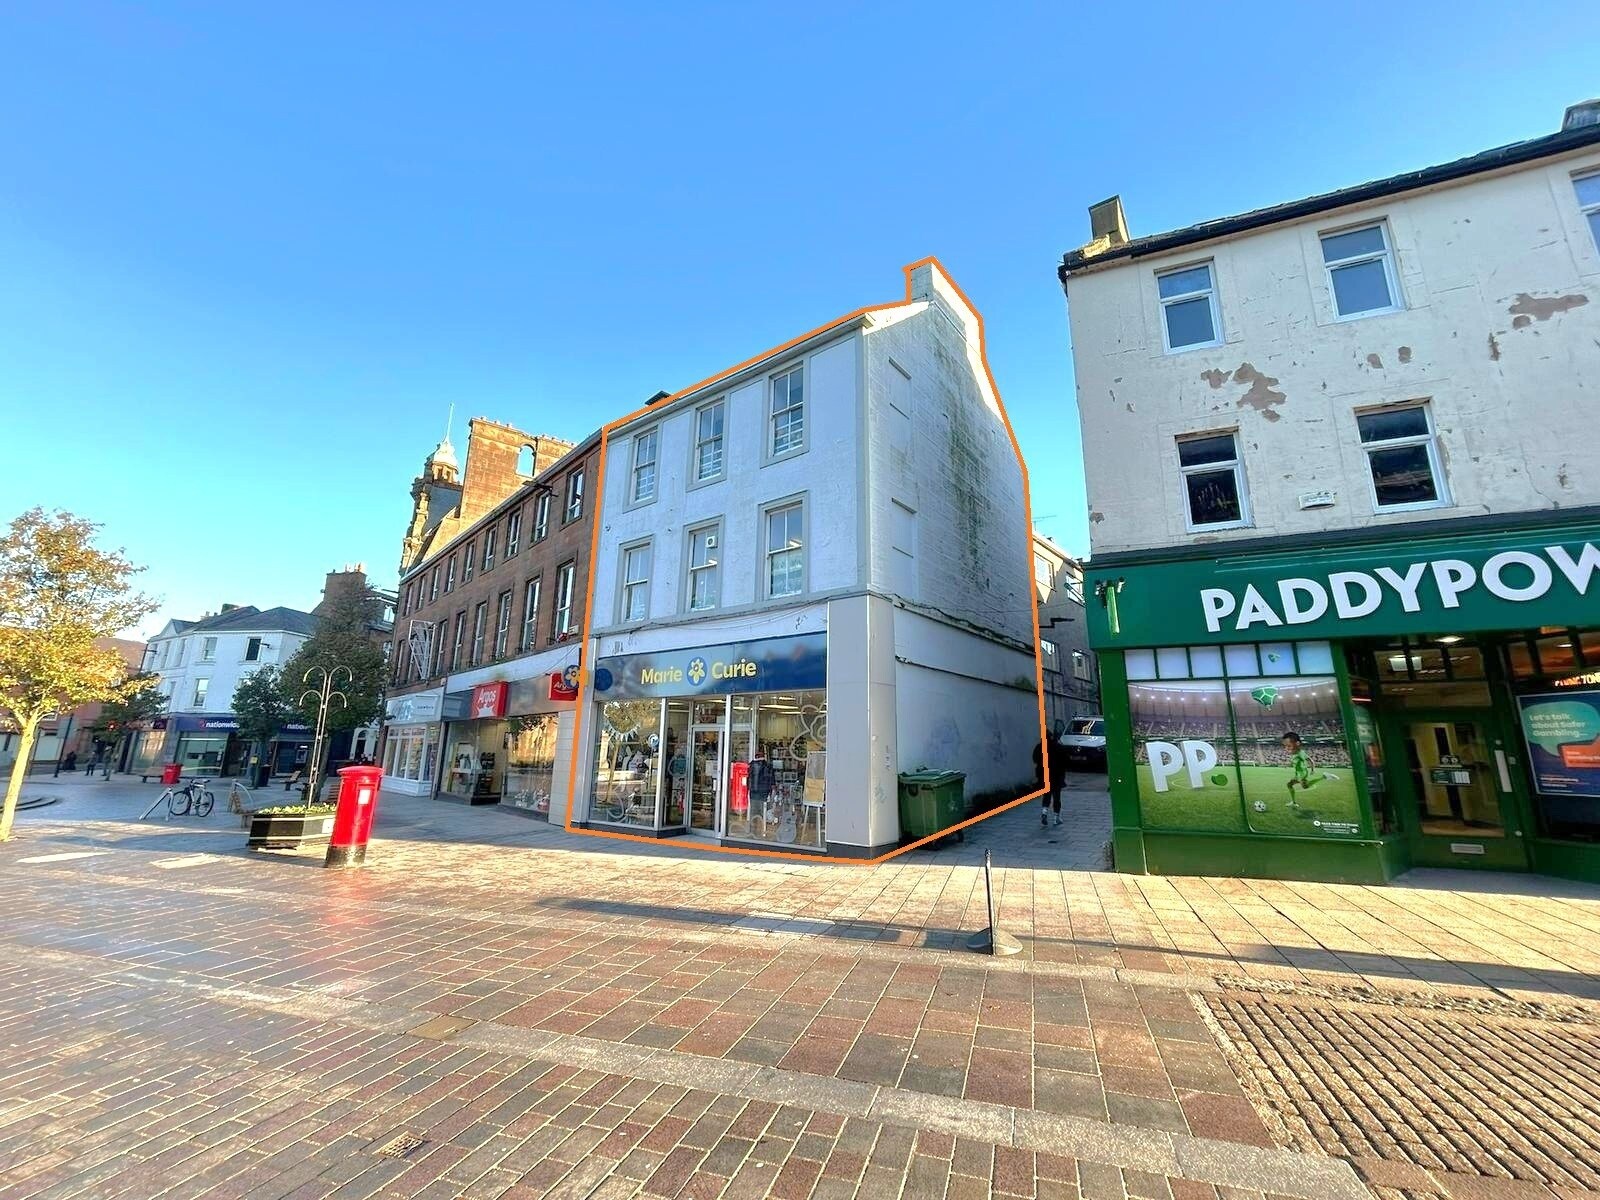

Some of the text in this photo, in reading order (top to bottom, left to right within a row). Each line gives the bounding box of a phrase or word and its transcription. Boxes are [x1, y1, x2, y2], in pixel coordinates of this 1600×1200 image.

[641, 658, 757, 685] Marie Curie
[477, 687, 497, 705] Argos
